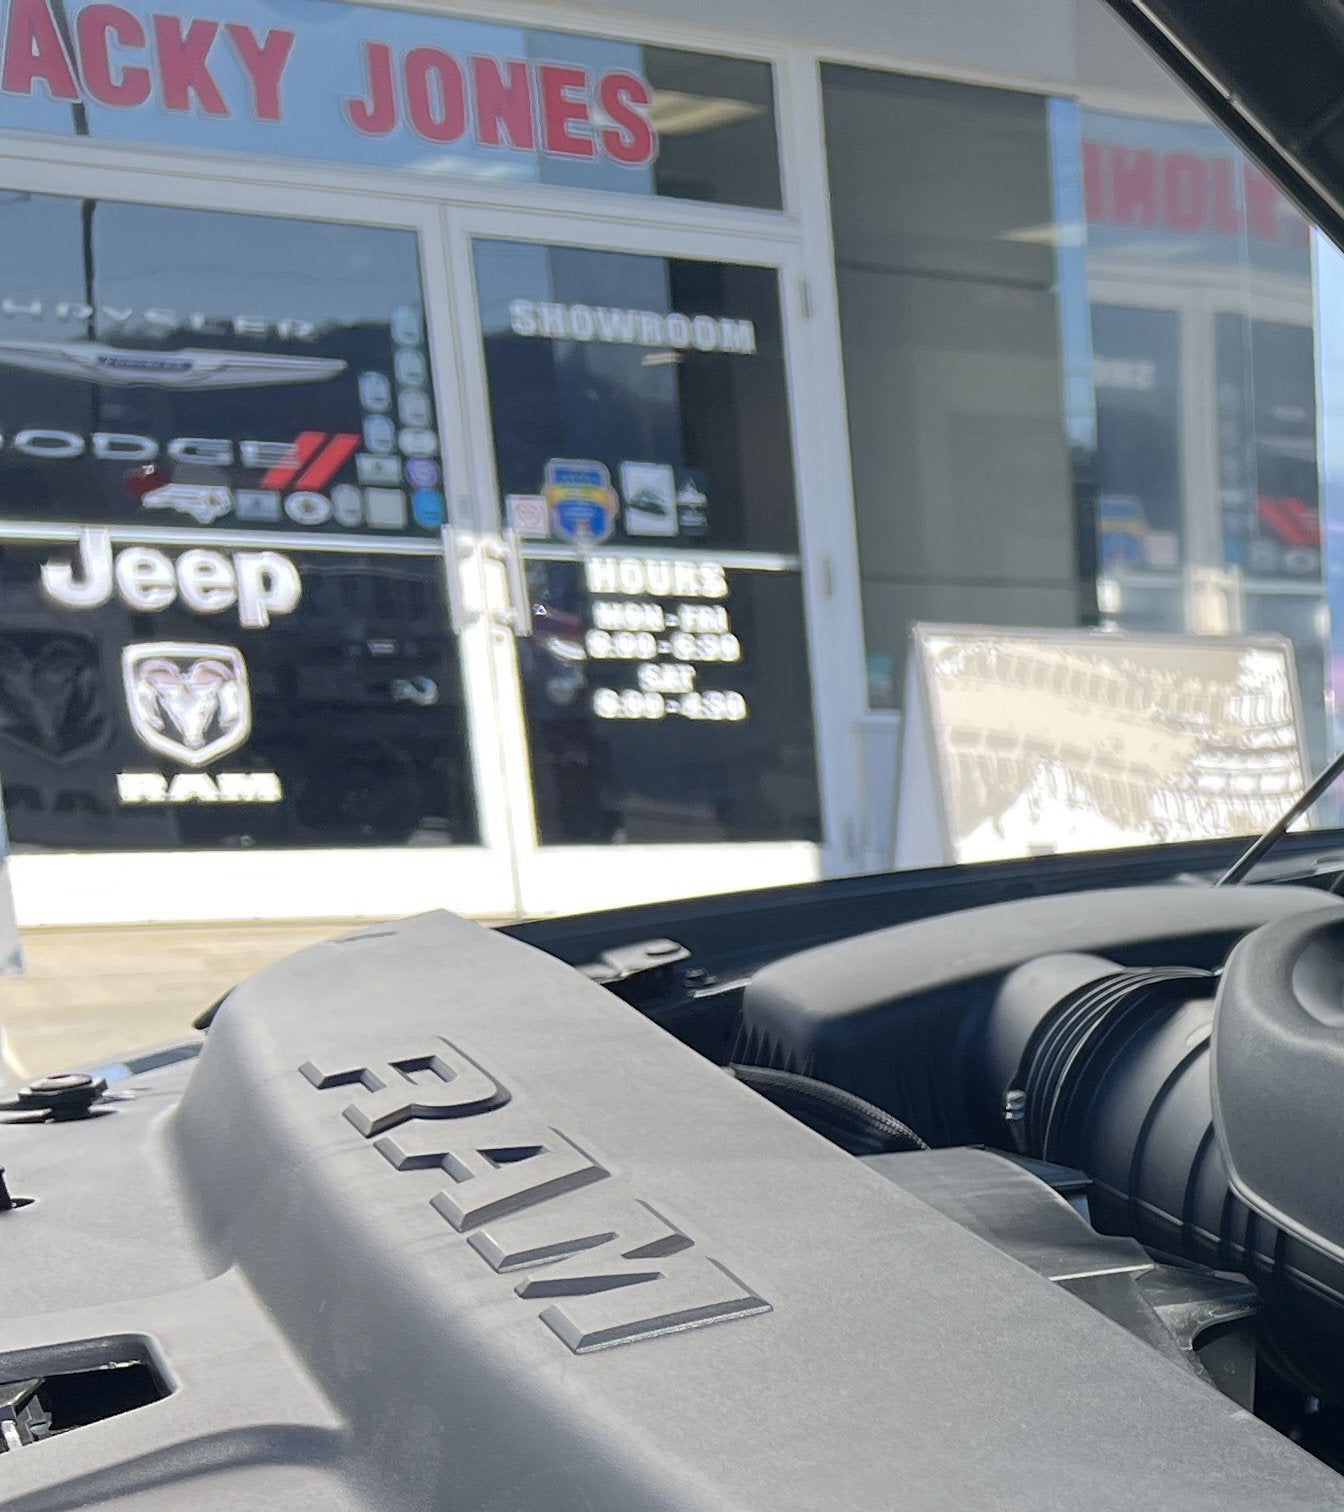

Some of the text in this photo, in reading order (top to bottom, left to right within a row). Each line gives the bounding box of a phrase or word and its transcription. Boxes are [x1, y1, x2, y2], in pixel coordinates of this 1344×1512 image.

[1, 0, 655, 167] ACKY JONES
[509, 299, 757, 355] SHOWROOM
[0, 428, 302, 470] ODGE
[40, 528, 302, 629] Jeep
[587, 556, 729, 598] HOURS
[116, 771, 283, 805] RAM
[299, 1034, 774, 1355] RAM
